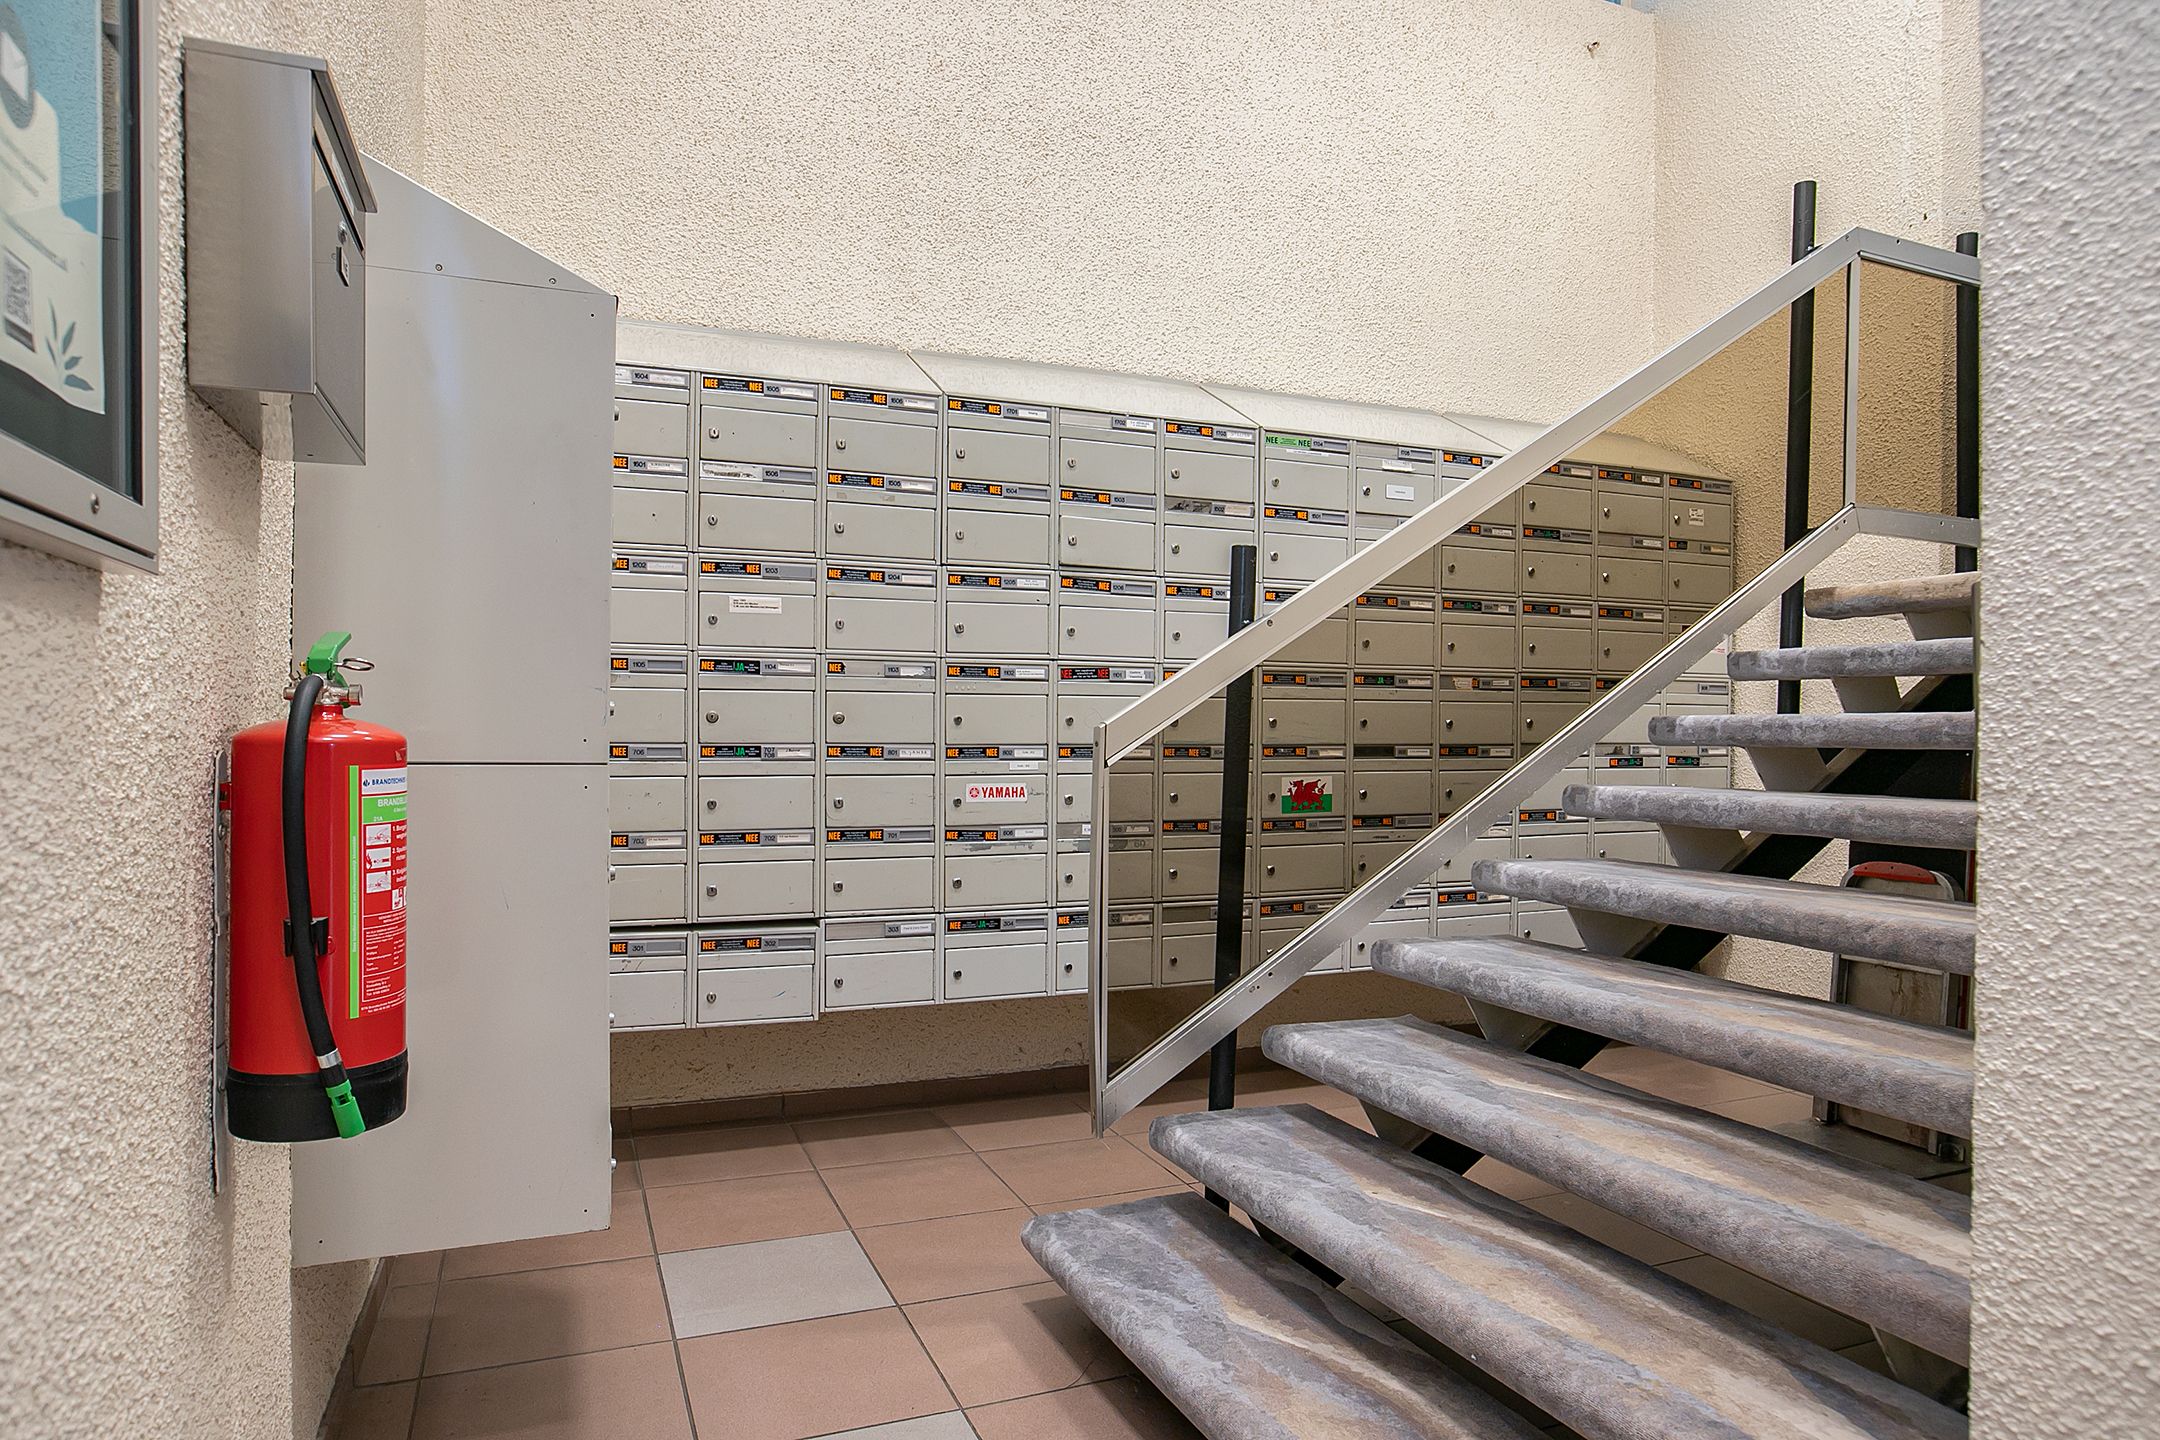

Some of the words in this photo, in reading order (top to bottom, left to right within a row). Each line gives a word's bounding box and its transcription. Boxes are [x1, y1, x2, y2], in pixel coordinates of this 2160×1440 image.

[634, 372, 649, 380] 1604
[705, 379, 718, 388] NEE
[749, 383, 762, 392] NEE
[832, 391, 844, 400] NEE
[874, 395, 886, 404] NEE
[950, 401, 961, 410] NEE
[989, 405, 1000, 414] NEE
[1167, 424, 1178, 433] NEE
[1201, 428, 1212, 436] NEE
[1266, 435, 1278, 444] NEE
[1298, 439, 1311, 448] NEE
[830, 474, 842, 483] NEE
[871, 478, 883, 487] NEE
[951, 483, 962, 491] NEE
[990, 486, 1001, 495] NEE
[1062, 491, 1073, 500] NEE
[1099, 495, 1110, 503] NEE
[1266, 509, 1276, 517] NEE
[1298, 512, 1307, 520] NEE
[633, 561, 647, 569] 1202
[702, 562, 716, 572] NEE
[747, 565, 760, 574] NEE
[829, 570, 841, 579] NEE
[870, 573, 882, 581] NEE
[950, 576, 961, 584] NEE
[989, 578, 1000, 586] NEE
[1062, 579, 1073, 587] NEE
[1099, 582, 1110, 591] NEE
[1167, 587, 1177, 595] NEE
[1201, 589, 1212, 597] NEE
[1265, 592, 1276, 601] NEE
[613, 660, 627, 669] NEE
[701, 660, 715, 671] NEE
[735, 661, 745, 673] JA
[764, 662, 778, 670] 1104
[829, 664, 841, 672] NEE
[949, 667, 960, 676] NEE
[988, 669, 999, 677] NEE
[1061, 668, 1073, 679] NEE
[1097, 668, 1109, 678] NEE
[1264, 676, 1274, 684] NEE
[1296, 676, 1306, 684] NEE
[613, 748, 626, 757] NEE
[633, 748, 645, 756] 706
[702, 747, 716, 757] NEE
[736, 747, 745, 759] JA
[829, 748, 841, 757] NEE
[870, 748, 882, 757] NEE
[948, 749, 960, 757] NEE
[987, 748, 998, 757] NEE
[1060, 749, 1071, 757] NEE
[1164, 748, 1175, 757] NEE
[1189, 748, 1199, 757] NEE
[982, 787, 1025, 798] YAMAHA
[1163, 823, 1174, 831] NEE
[1198, 822, 1208, 831] NEE
[633, 836, 645, 844] 703
[702, 835, 715, 844] NEE
[746, 833, 759, 843] NEE
[829, 832, 841, 841] NEE
[870, 831, 882, 840] NEE
[946, 832, 959, 840] NEE
[985, 832, 997, 840] NEE
[613, 837, 626, 846] NEE
[950, 922, 961, 930] NEE
[977, 919, 987, 929] JA
[1059, 916, 1070, 925] NEE
[613, 944, 626, 953] NEE
[632, 943, 644, 951] 301
[703, 942, 716, 951] NEE
[747, 939, 760, 948] NEE
